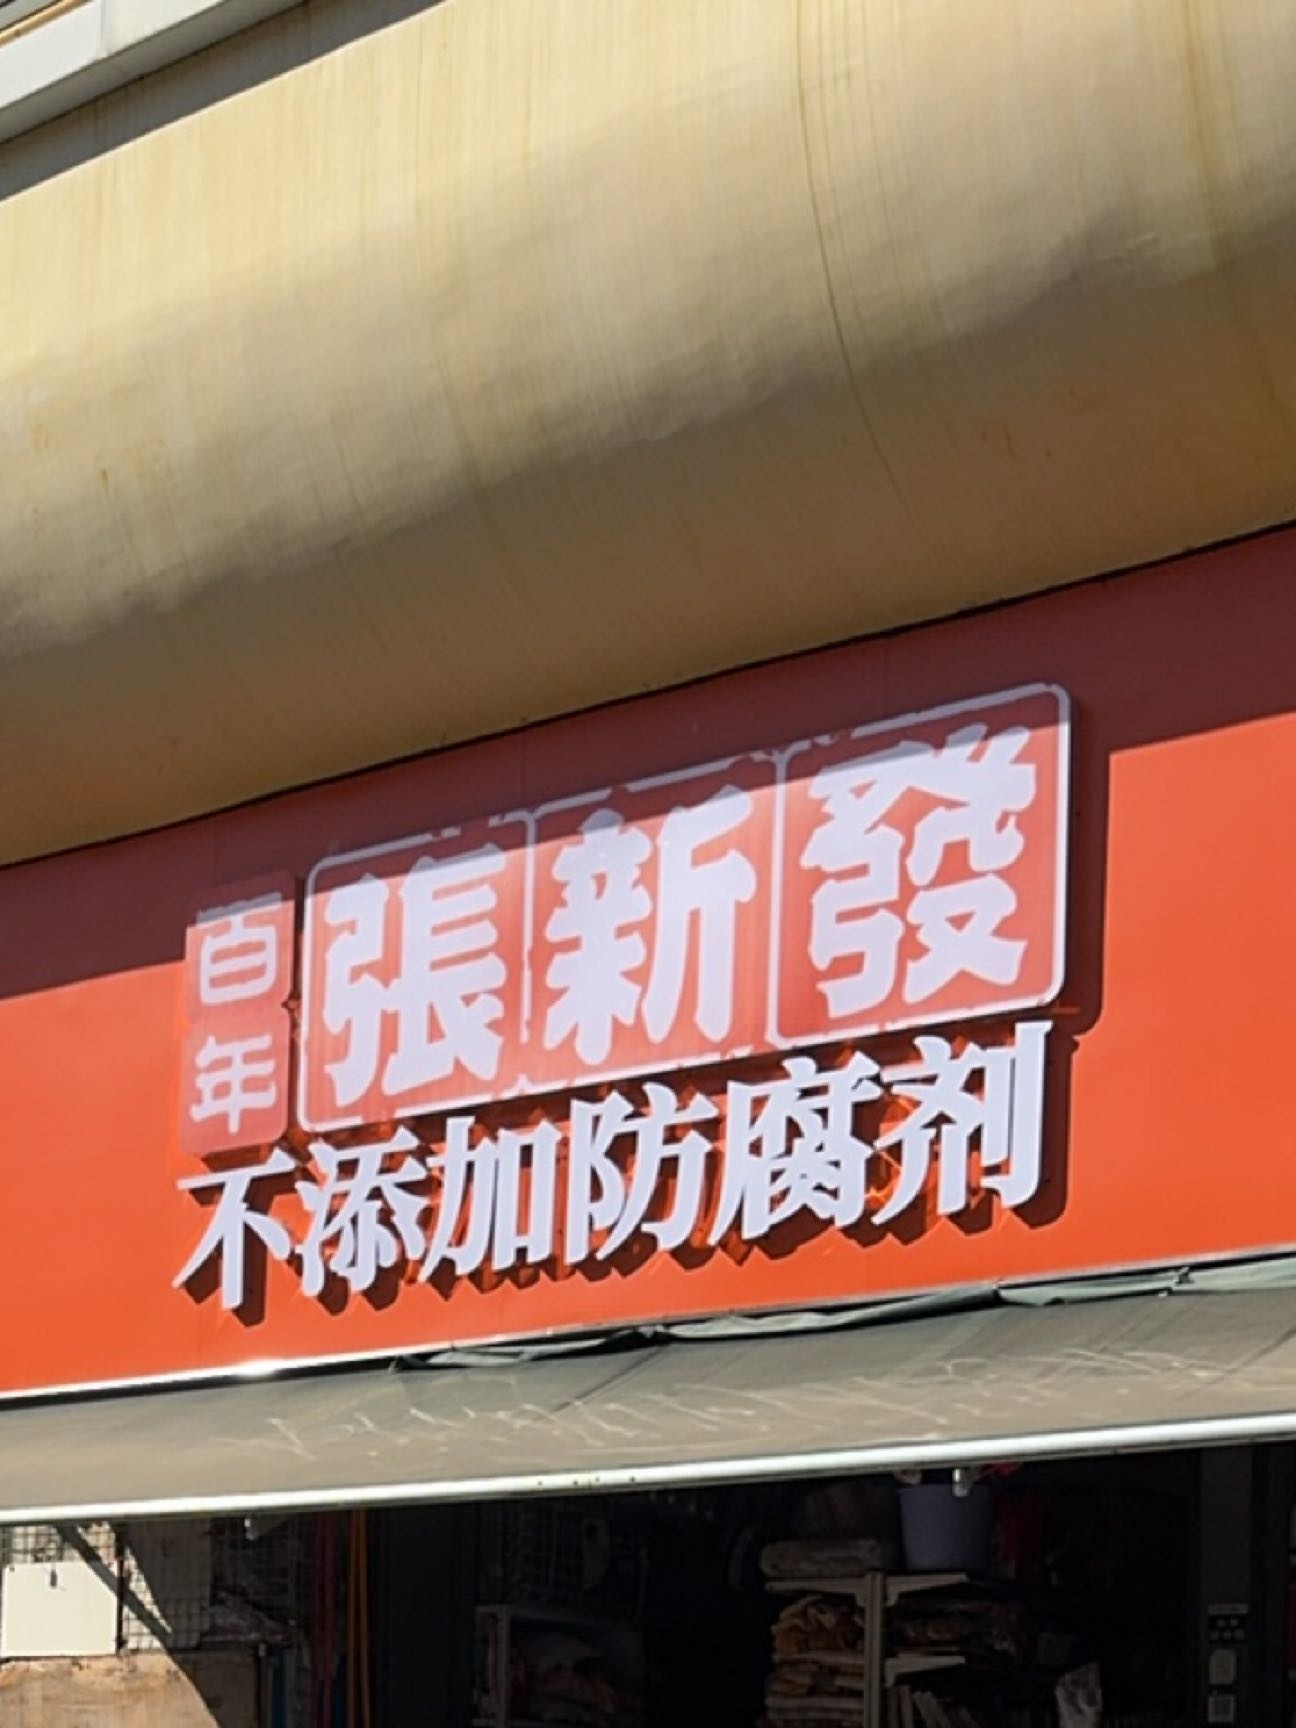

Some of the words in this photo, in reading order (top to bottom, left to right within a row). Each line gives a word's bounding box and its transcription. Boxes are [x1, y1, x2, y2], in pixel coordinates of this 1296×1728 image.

[189, 893, 284, 1137] 百年
[322, 722, 1039, 1108] 張新發
[173, 1020, 1053, 1310] 不添加防腐剂
